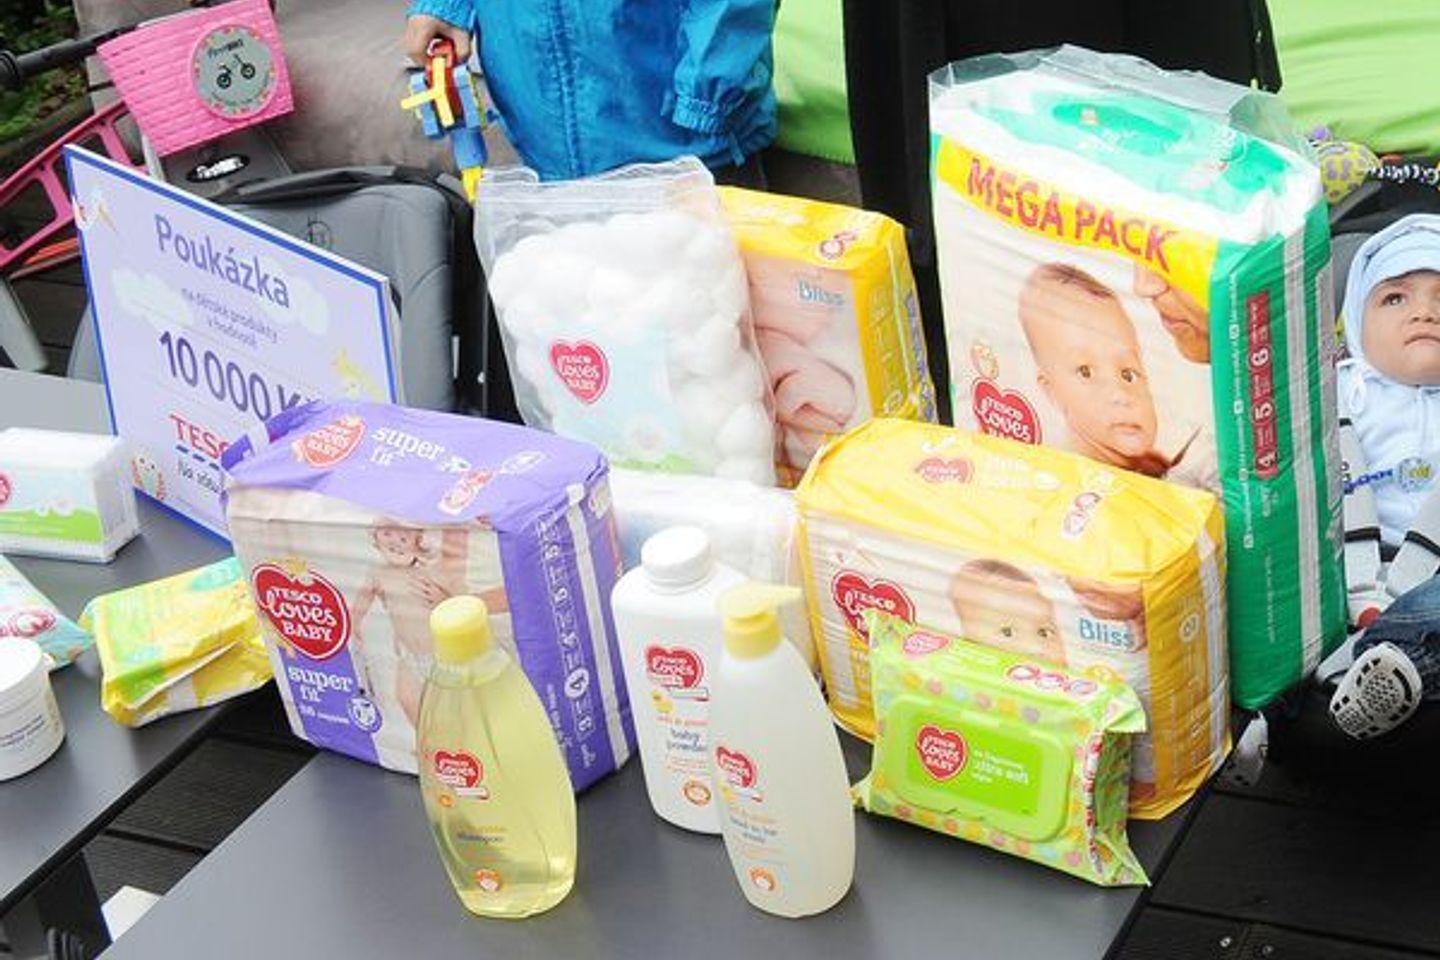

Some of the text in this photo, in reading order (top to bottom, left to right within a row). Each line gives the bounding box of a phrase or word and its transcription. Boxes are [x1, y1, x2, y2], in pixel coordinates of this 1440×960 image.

[968, 157, 1179, 273] MEGA PACK
[154, 213, 290, 309] Poukázka
[1255, 402, 1273, 421] 5
[371, 425, 446, 461] super
[270, 586, 323, 605] TESCO
[283, 619, 334, 642] BABY
[1078, 617, 1137, 649] Bliss
[287, 666, 354, 693] super
